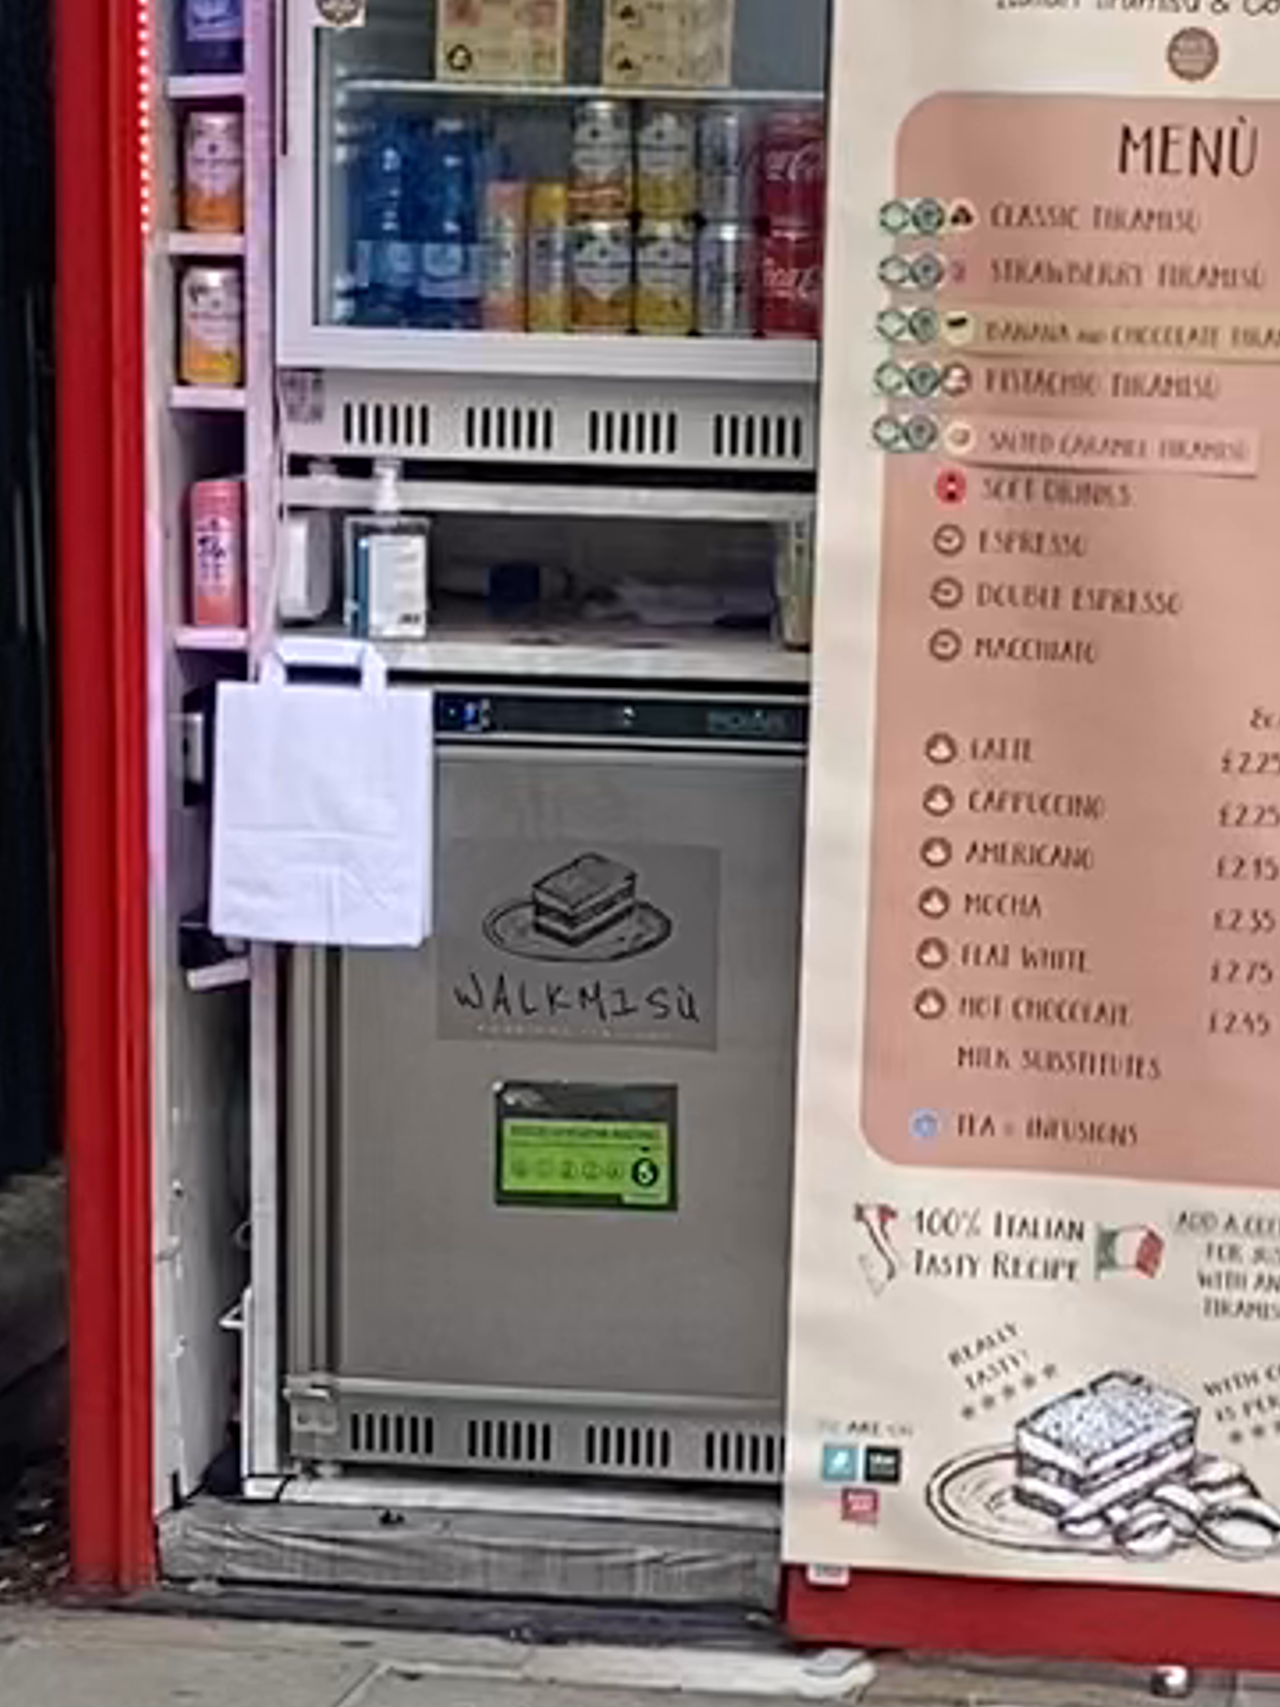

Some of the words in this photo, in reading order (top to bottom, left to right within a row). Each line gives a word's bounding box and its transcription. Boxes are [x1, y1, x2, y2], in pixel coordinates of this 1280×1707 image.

[1118, 115, 1258, 178] MENÙ
[990, 200, 1080, 229] CLASSIC
[990, 257, 1144, 288] STRAWBERRY
[986, 322, 1069, 343] BANANA
[1111, 325, 1219, 346] CHOCOLATE
[986, 368, 1099, 396] PISTACHIO
[989, 431, 1054, 454] SALTED
[1058, 434, 1148, 458] CARAMEL
[984, 478, 1033, 502] SOFT
[1043, 480, 1133, 508] DRINKS
[979, 530, 1088, 558] ESPRESSO
[976, 583, 1062, 610] DOUBLE
[1072, 588, 1184, 616] ESPRESSO
[974, 637, 1100, 664] MACCHIATO
[969, 737, 1034, 763] LATTE
[968, 790, 1106, 820] CAPPUCCINO
[965, 840, 1095, 871] AMERICANO
[964, 892, 1042, 918] MOCHA
[961, 944, 1010, 968] FLAT
[1021, 946, 1091, 974] WHITE
[959, 995, 1002, 1018] HOT
[1012, 996, 1132, 1027] CHOCOLATE
[956, 1045, 1011, 1070] MILK
[1021, 1048, 1163, 1080] SUBSTITUTES
[957, 1113, 996, 1138] TEA
[1025, 1116, 1139, 1147] INFUSIONS
[915, 1208, 981, 1238] 100%
[993, 1211, 1086, 1242] ITALIAN
[1177, 1210, 1218, 1233] ADD
[1224, 1213, 1240, 1233] A
[914, 1248, 982, 1279] TASTY
[993, 1249, 1080, 1283] RECIPE
[1206, 1243, 1243, 1261] FOR
[1197, 1271, 1247, 1290] WITH
[947, 1320, 1020, 1369] REALLY
[1204, 1369, 1261, 1399] WITH
[848, 1420, 880, 1436] ARE
[1216, 1405, 1236, 1423] IS
